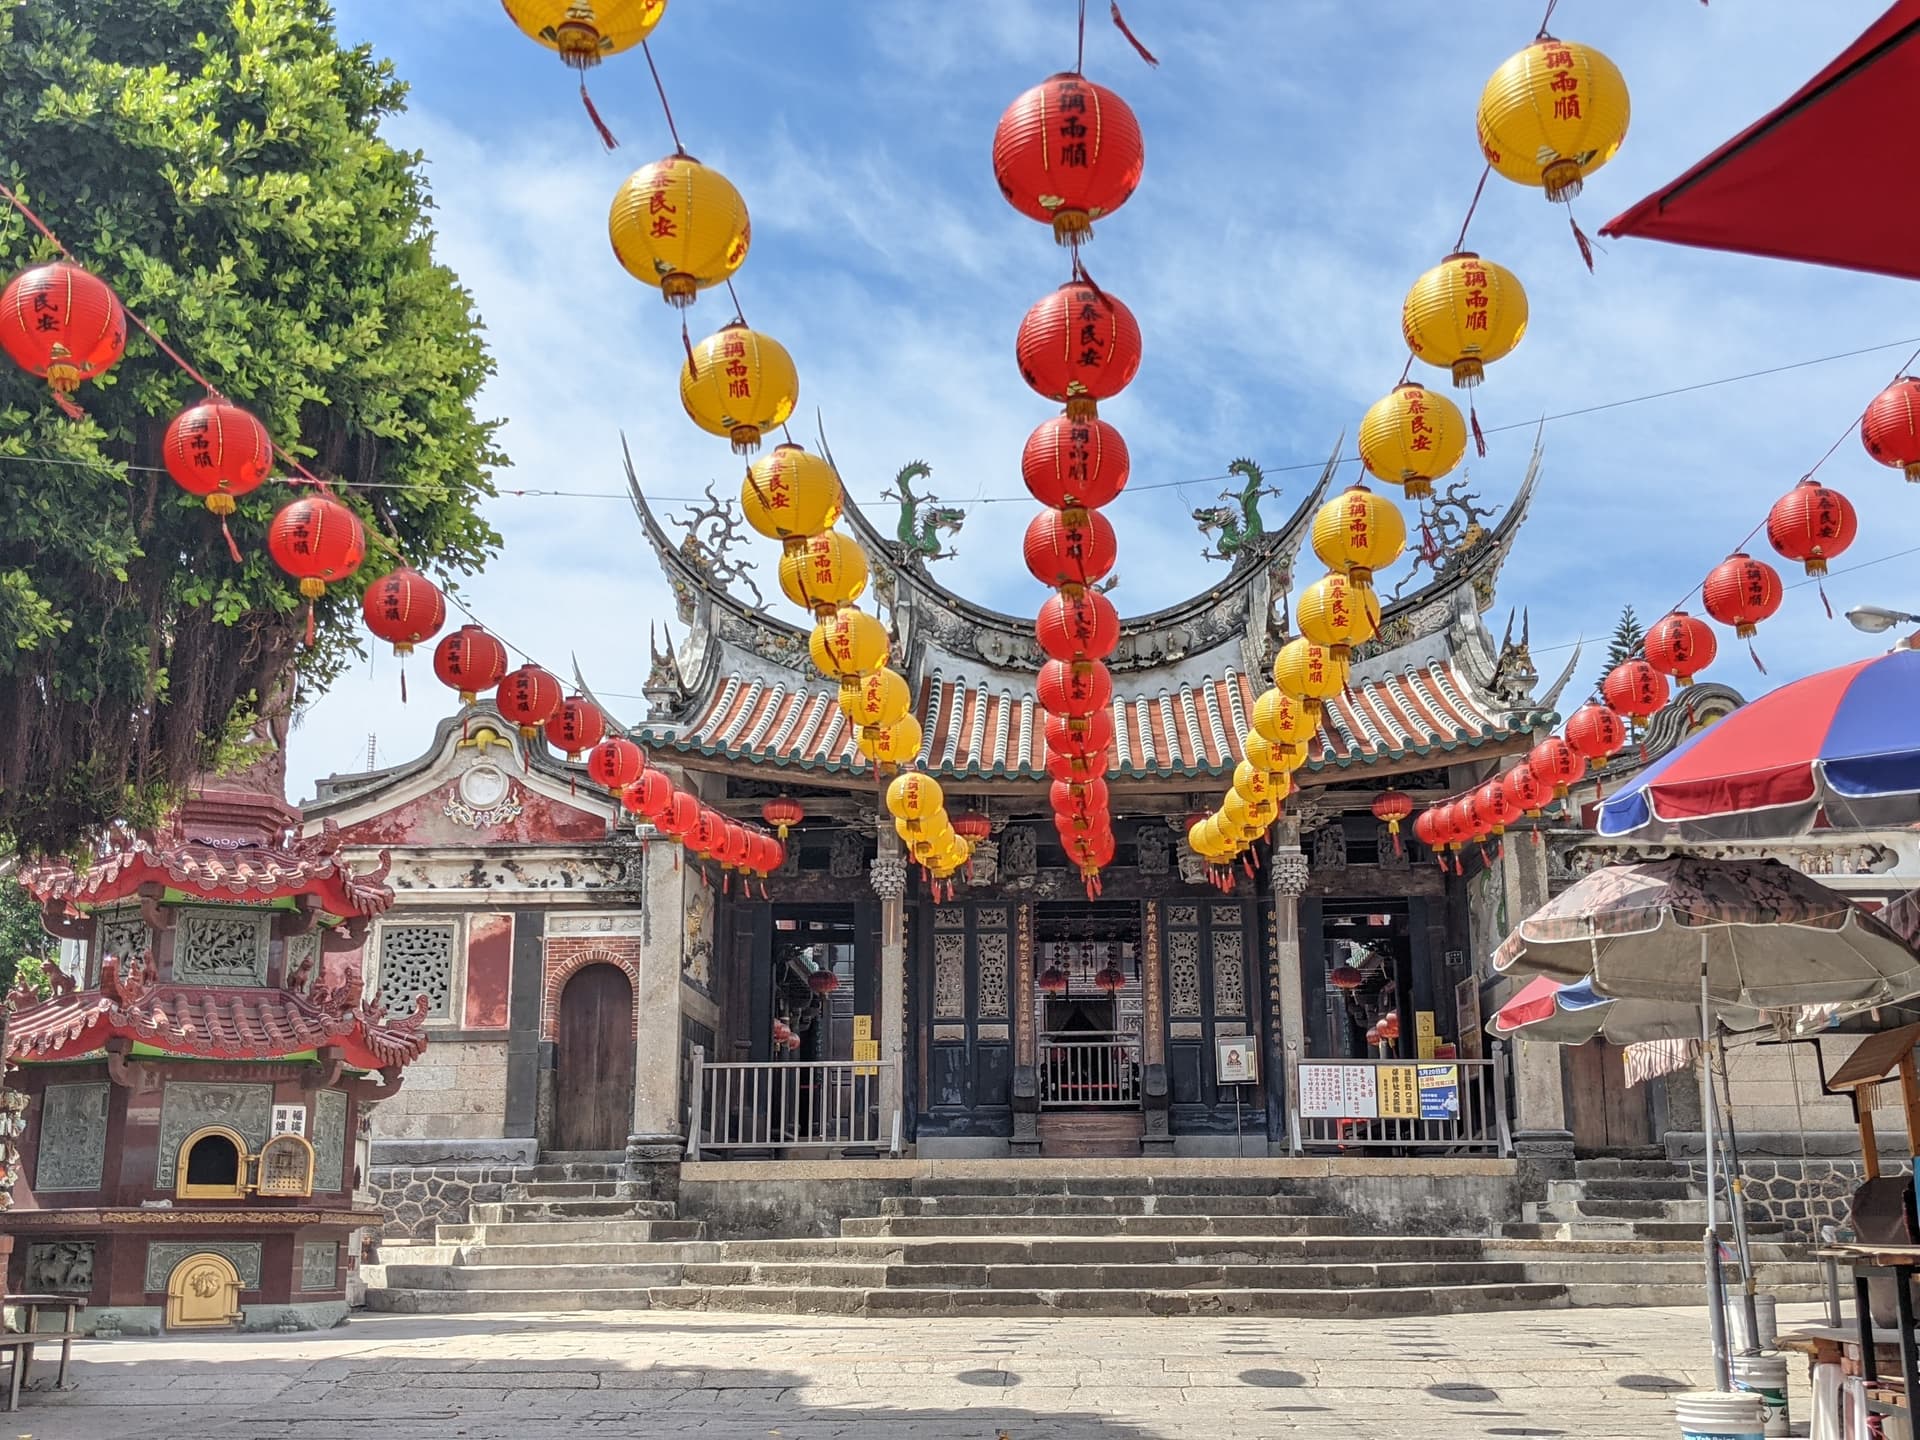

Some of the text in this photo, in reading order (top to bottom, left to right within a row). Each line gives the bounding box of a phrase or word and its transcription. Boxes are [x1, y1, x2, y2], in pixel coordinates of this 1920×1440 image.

[1461, 260, 1488, 331] 風調雨順
[1404, 390, 1432, 450] 國泰民安
